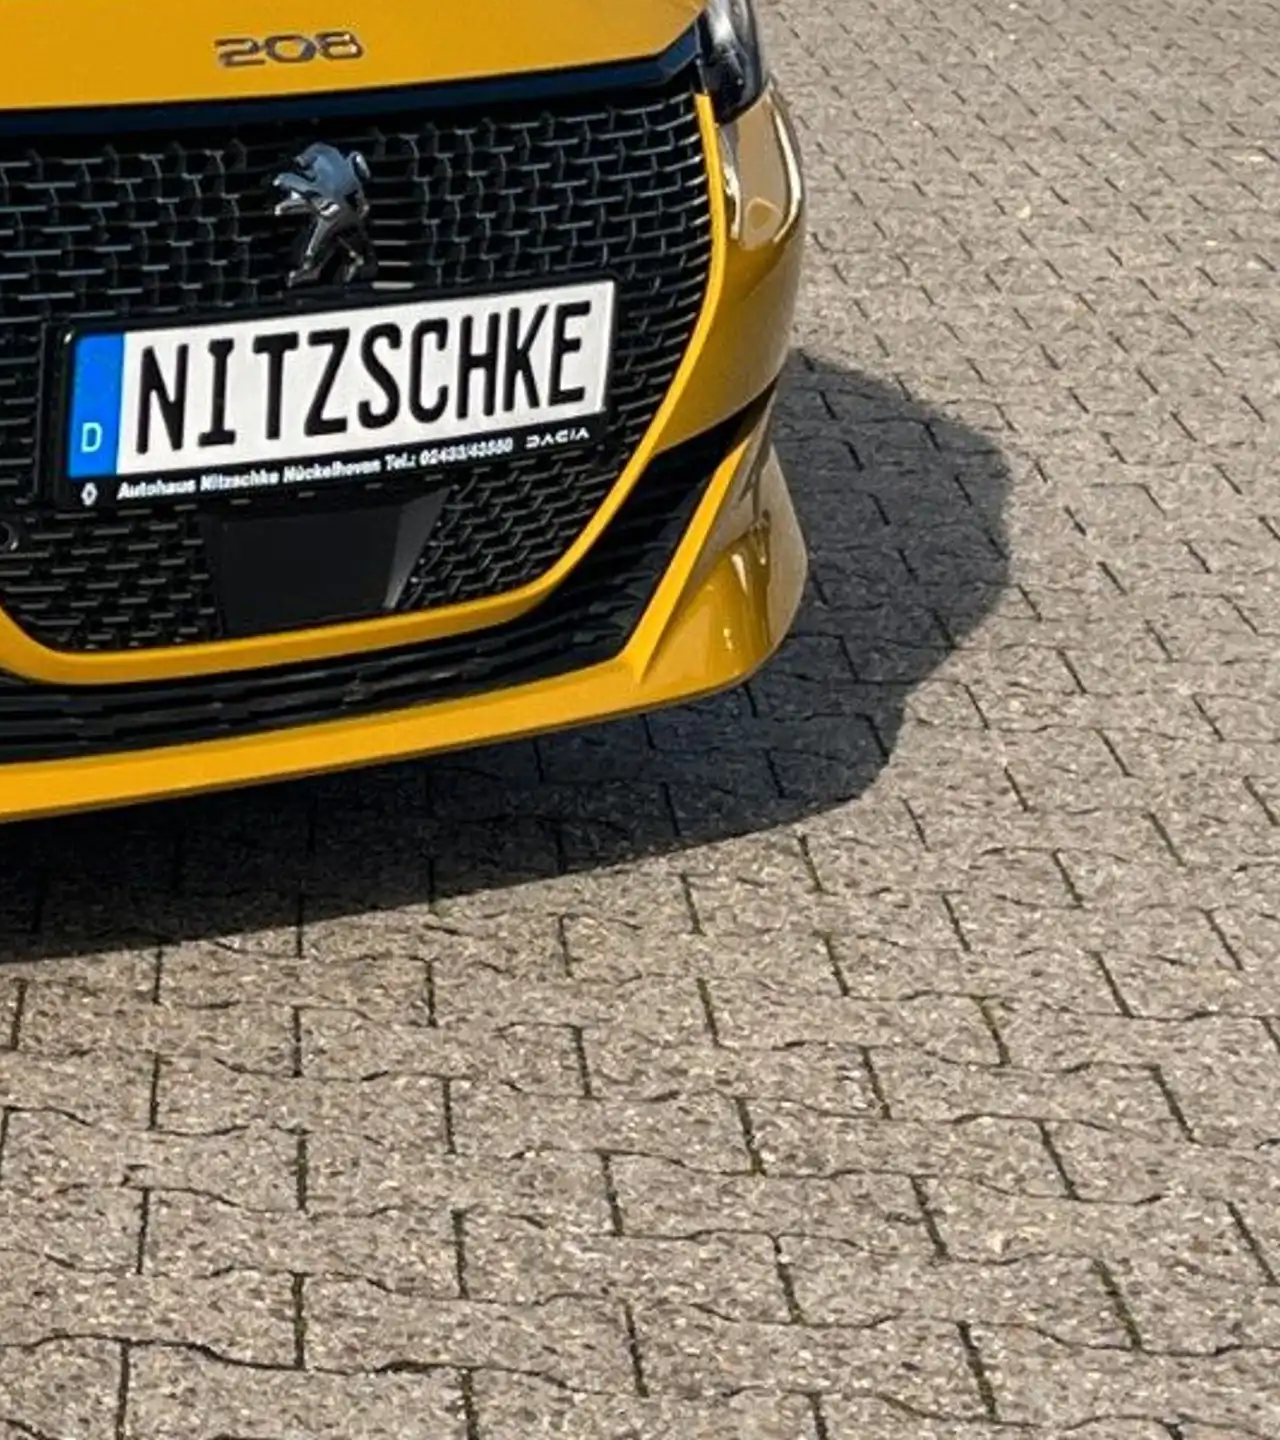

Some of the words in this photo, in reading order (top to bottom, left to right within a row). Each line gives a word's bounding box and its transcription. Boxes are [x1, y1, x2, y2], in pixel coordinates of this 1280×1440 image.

[214, 31, 363, 67] 208
[136, 300, 592, 455] NITZSCHKE
[81, 421, 104, 453] D
[117, 478, 197, 501] Autohaus
[200, 468, 280, 492] Nitzschke
[385, 451, 417, 471] Tel.:
[525, 427, 590, 449] DACIA
